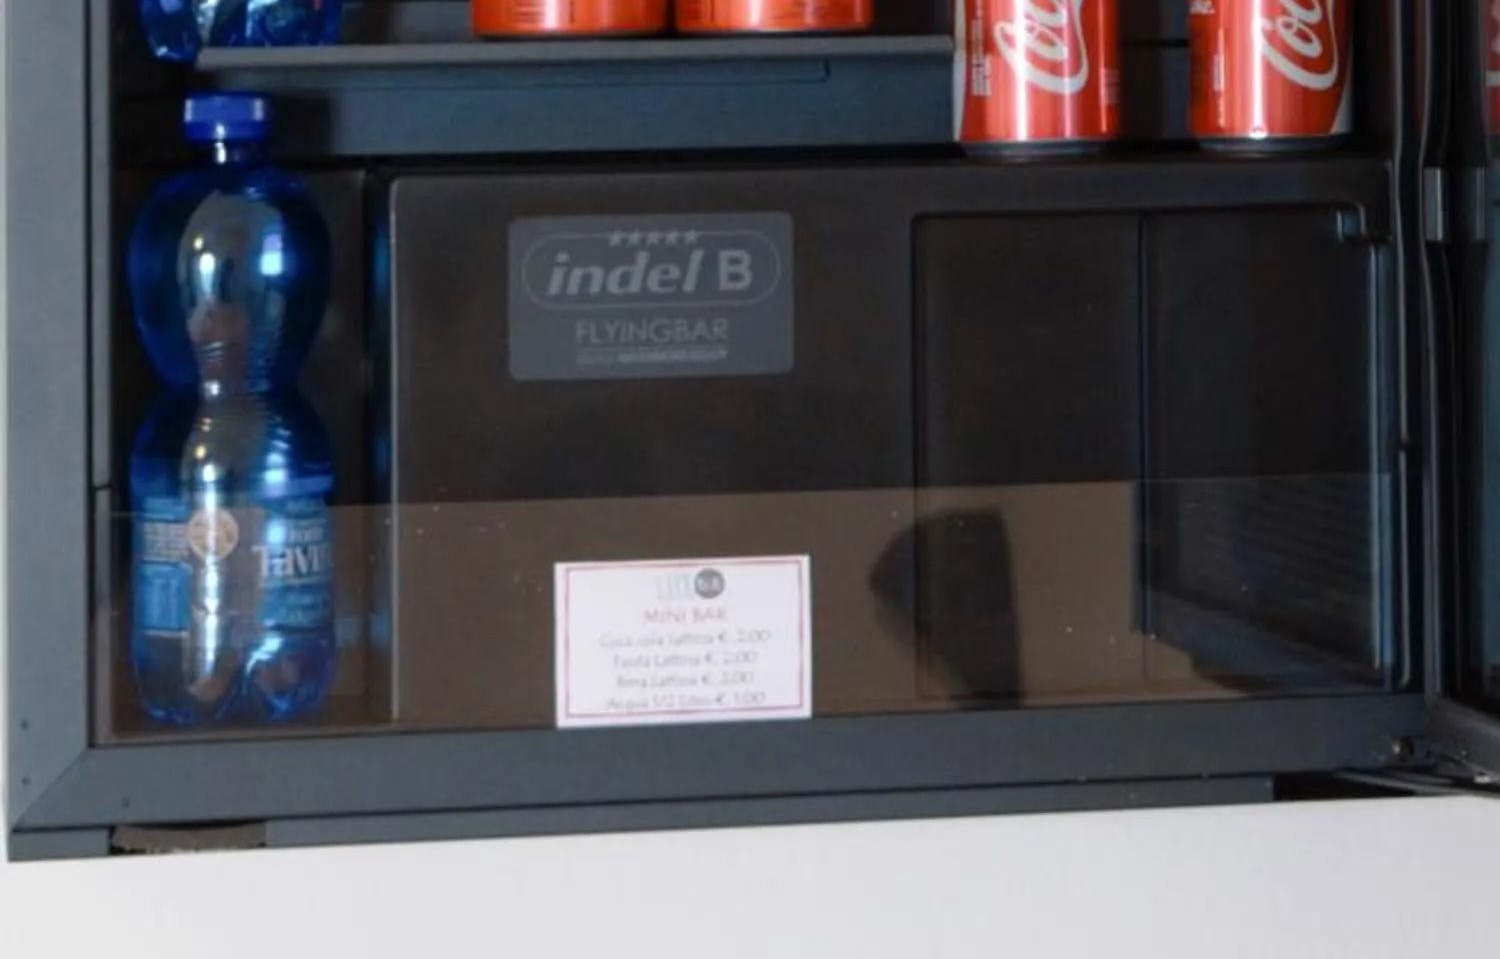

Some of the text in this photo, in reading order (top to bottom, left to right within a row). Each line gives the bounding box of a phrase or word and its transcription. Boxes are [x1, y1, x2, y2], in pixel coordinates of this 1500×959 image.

[546, 249, 753, 297] indel B
[574, 317, 730, 345] FLYINGBAR
[643, 606, 727, 624] MINI BAR
